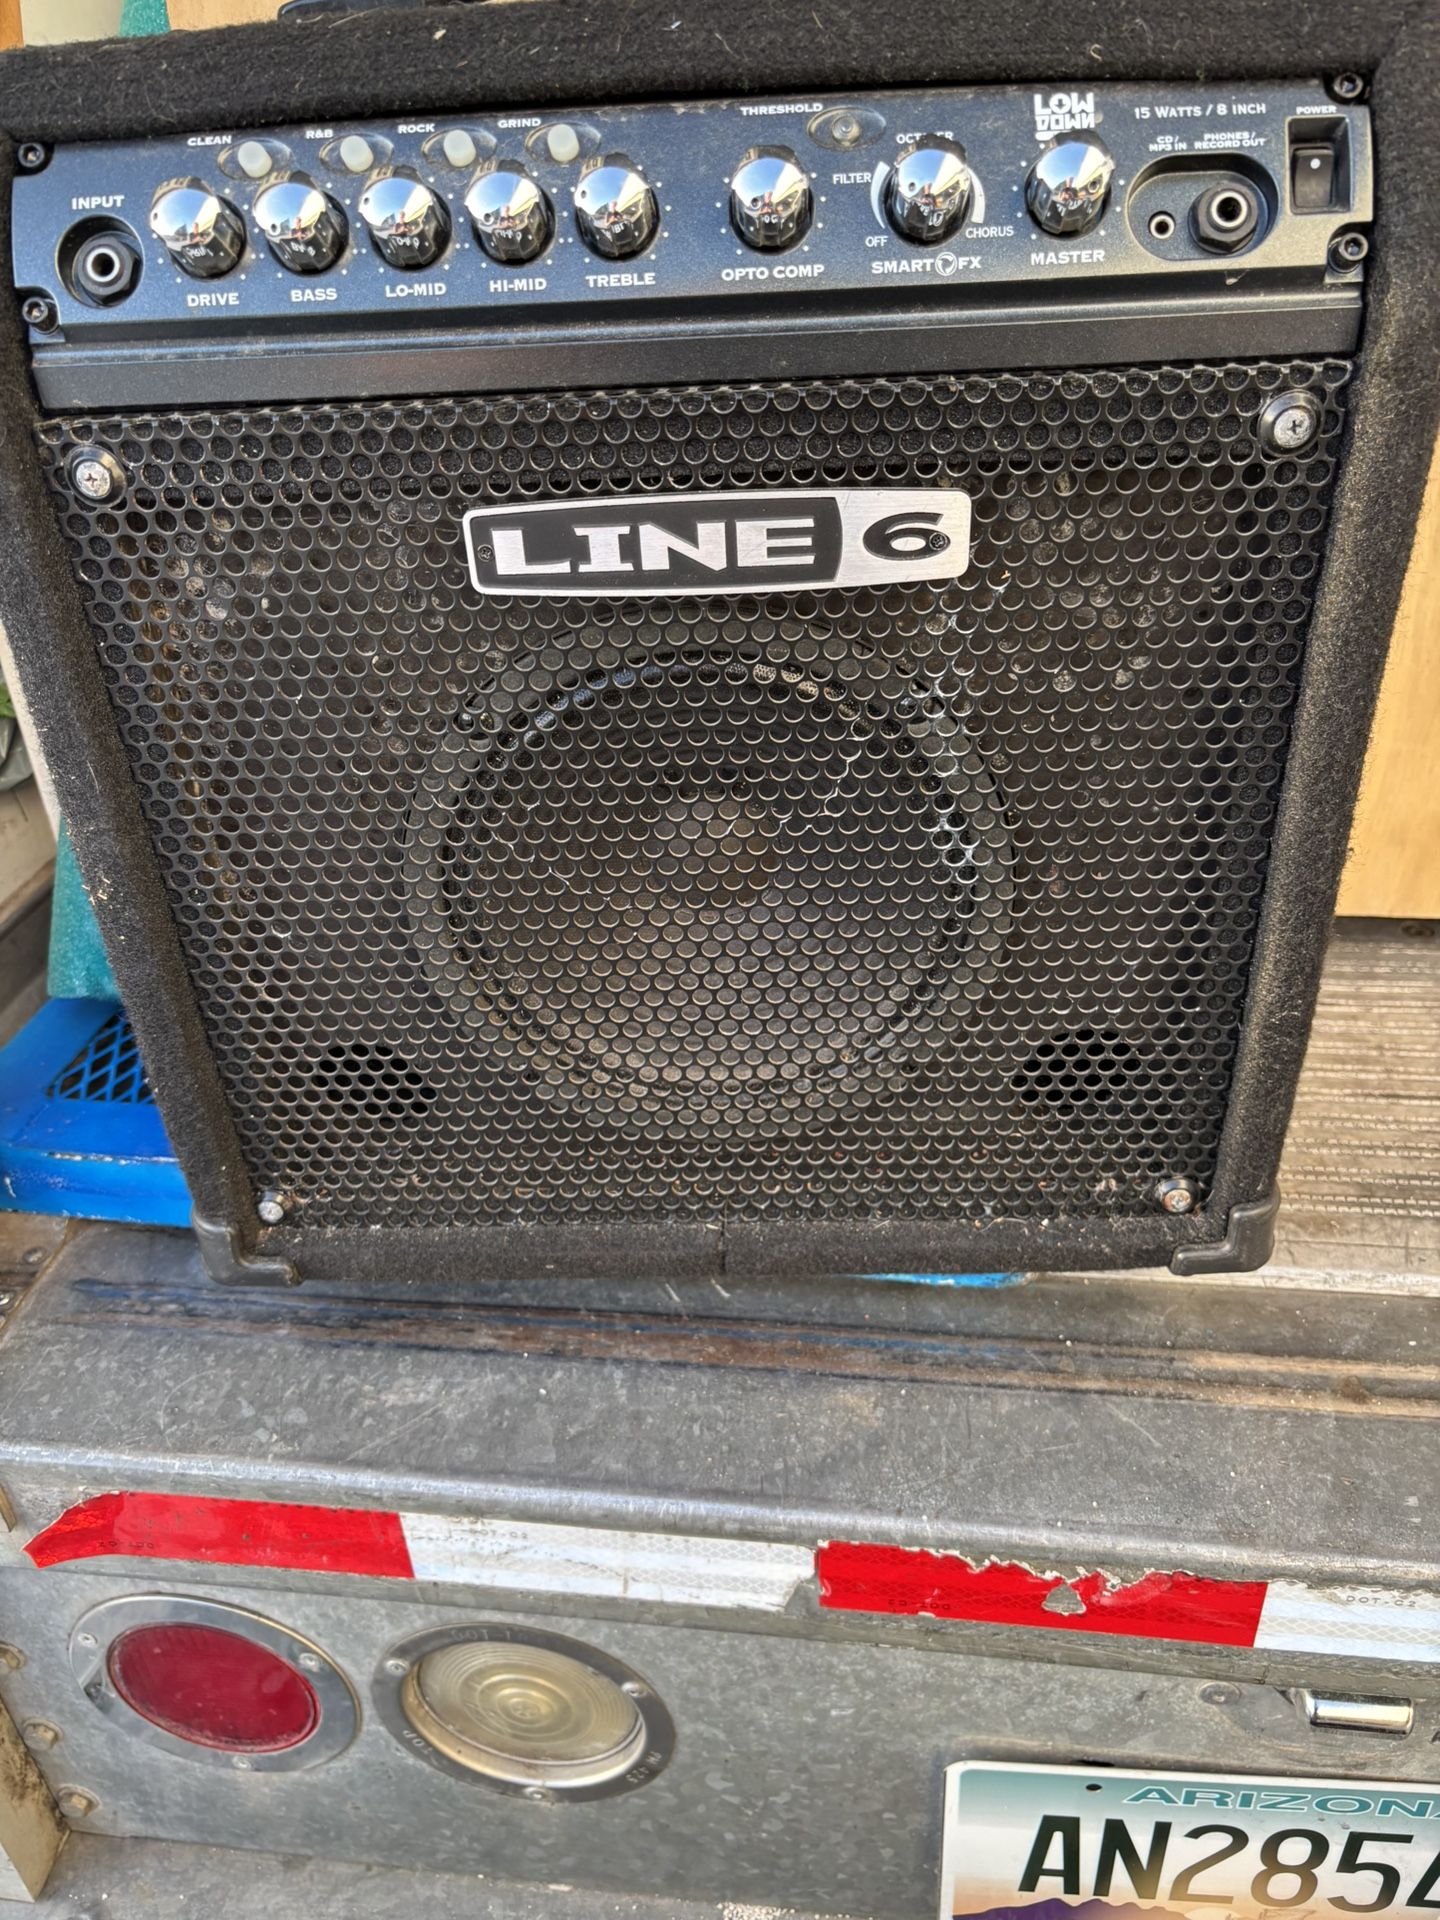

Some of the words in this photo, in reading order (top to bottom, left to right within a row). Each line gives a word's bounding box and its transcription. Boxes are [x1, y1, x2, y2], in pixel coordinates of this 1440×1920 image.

[740, 103, 823, 116] THRESHOLD
[1034, 92, 1094, 114] LOW
[1296, 105, 1337, 115] POWER
[1134, 107, 1150, 119] 15
[1154, 104, 1202, 118] WATTS
[1205, 104, 1212, 117] /
[1216, 103, 1228, 116] 8
[1232, 103, 1267, 116] INCH
[398, 122, 435, 134] ROCK
[498, 118, 541, 128] GRIND
[1035, 112, 1095, 131] DOWN
[187, 135, 232, 146] CLEAN
[305, 128, 334, 139] R&B
[896, 131, 955, 144] OCTR
[1149, 143, 1173, 152] MP3
[1174, 142, 1187, 151] IN
[1194, 140, 1240, 150] RECORD
[1242, 138, 1267, 147] OUT
[832, 173, 872, 185] FILTER
[71, 195, 125, 211] INPUT
[965, 226, 1014, 239] CHORUS
[865, 236, 889, 248] OFF
[871, 258, 935, 274] SMART
[958, 256, 982, 270] FX
[1030, 250, 1106, 266] MASTER
[586, 272, 656, 288] TREBLE
[721, 267, 769, 282] OPTO
[773, 264, 825, 279] COMP
[385, 282, 447, 298] LO-MID
[489, 278, 547, 293] HI-MID
[187, 292, 240, 307] DRIVE
[290, 288, 338, 304] BASS
[490, 518, 816, 576] LINE
[862, 512, 951, 562] 6
[1346, 1595, 1417, 1608] DOT-C2
[1122, 1786, 1440, 1819] ARIZON
